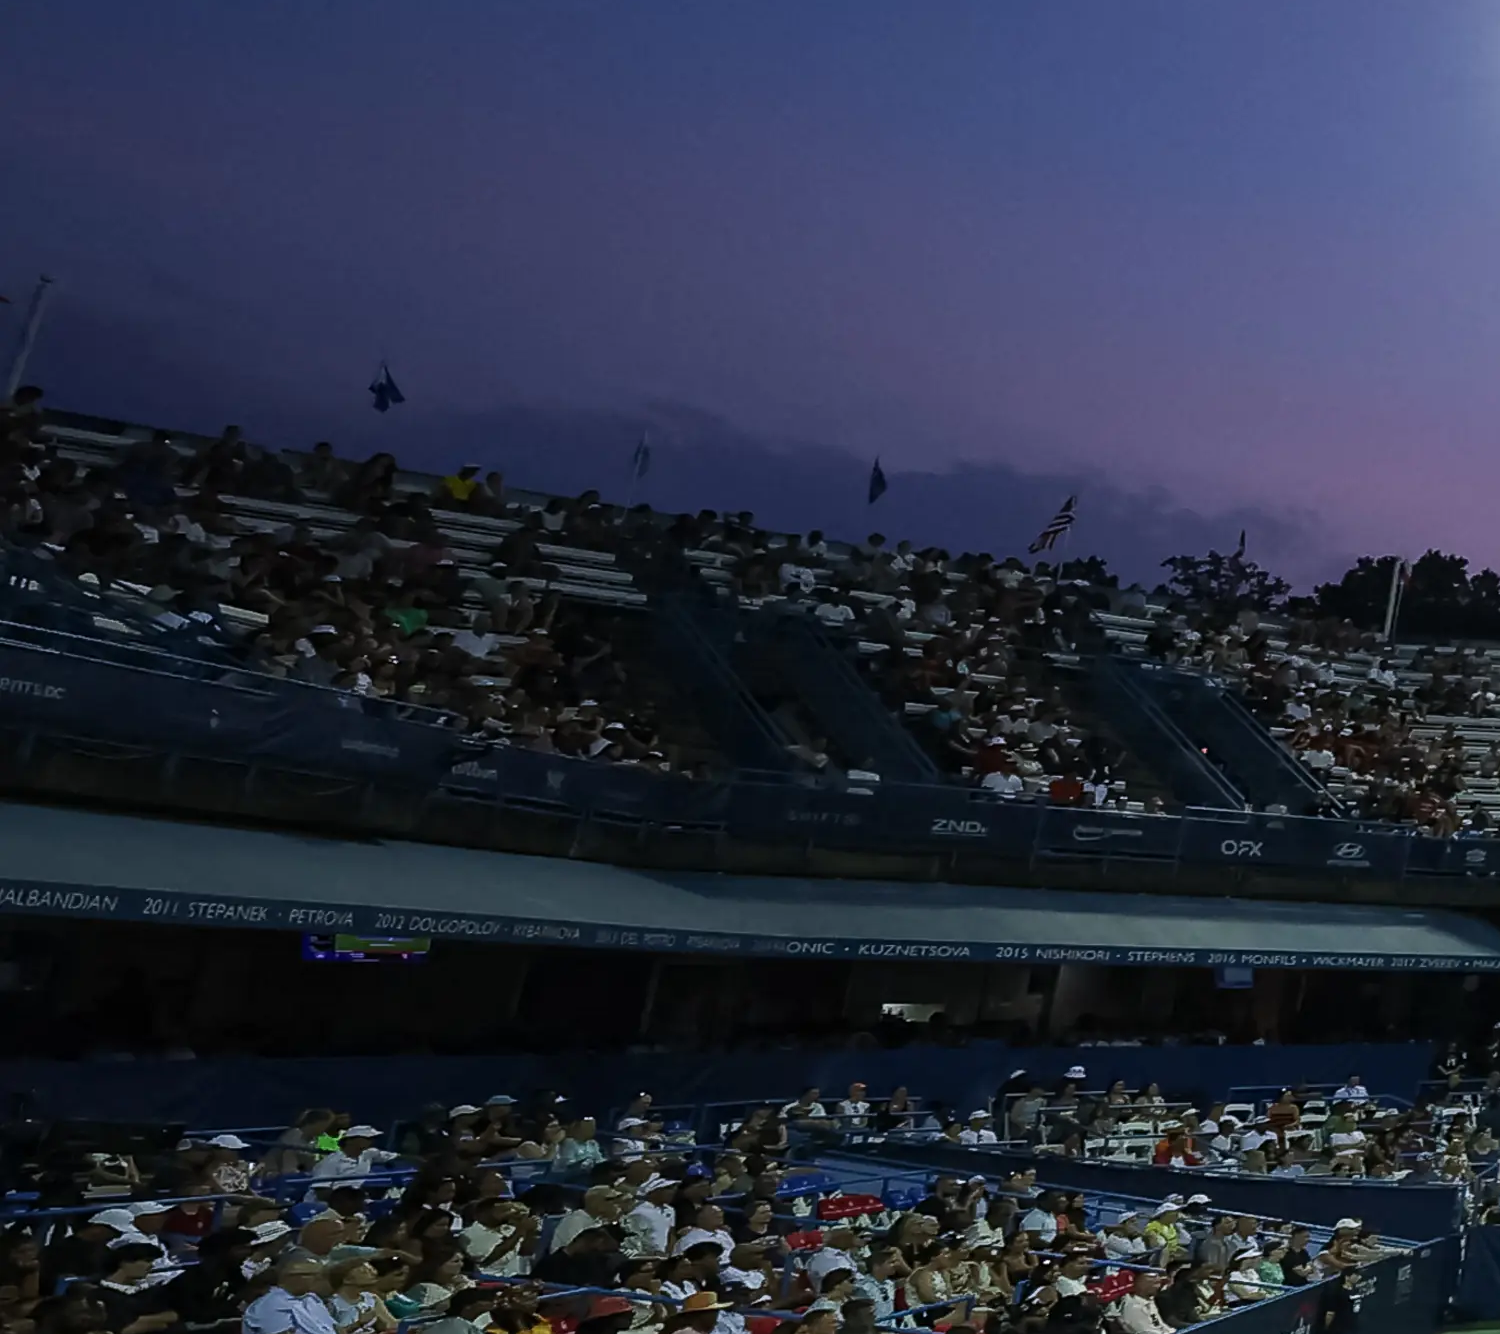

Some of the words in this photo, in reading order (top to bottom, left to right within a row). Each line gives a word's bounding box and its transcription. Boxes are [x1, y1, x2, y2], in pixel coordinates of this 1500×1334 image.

[1221, 840, 1263, 857] OFX
[143, 897, 180, 916] 2011
[188, 900, 268, 921] STEPANEK
[289, 909, 354, 927] PETROVA
[375, 913, 405, 930] 2012
[771, 940, 835, 955] ONIC
[858, 942, 970, 958] KUZNETSOVA
[1036, 948, 1110, 961] NISHIKORI
[1128, 950, 1196, 963] STEPHENS
[1242, 954, 1297, 966] MONFILS
